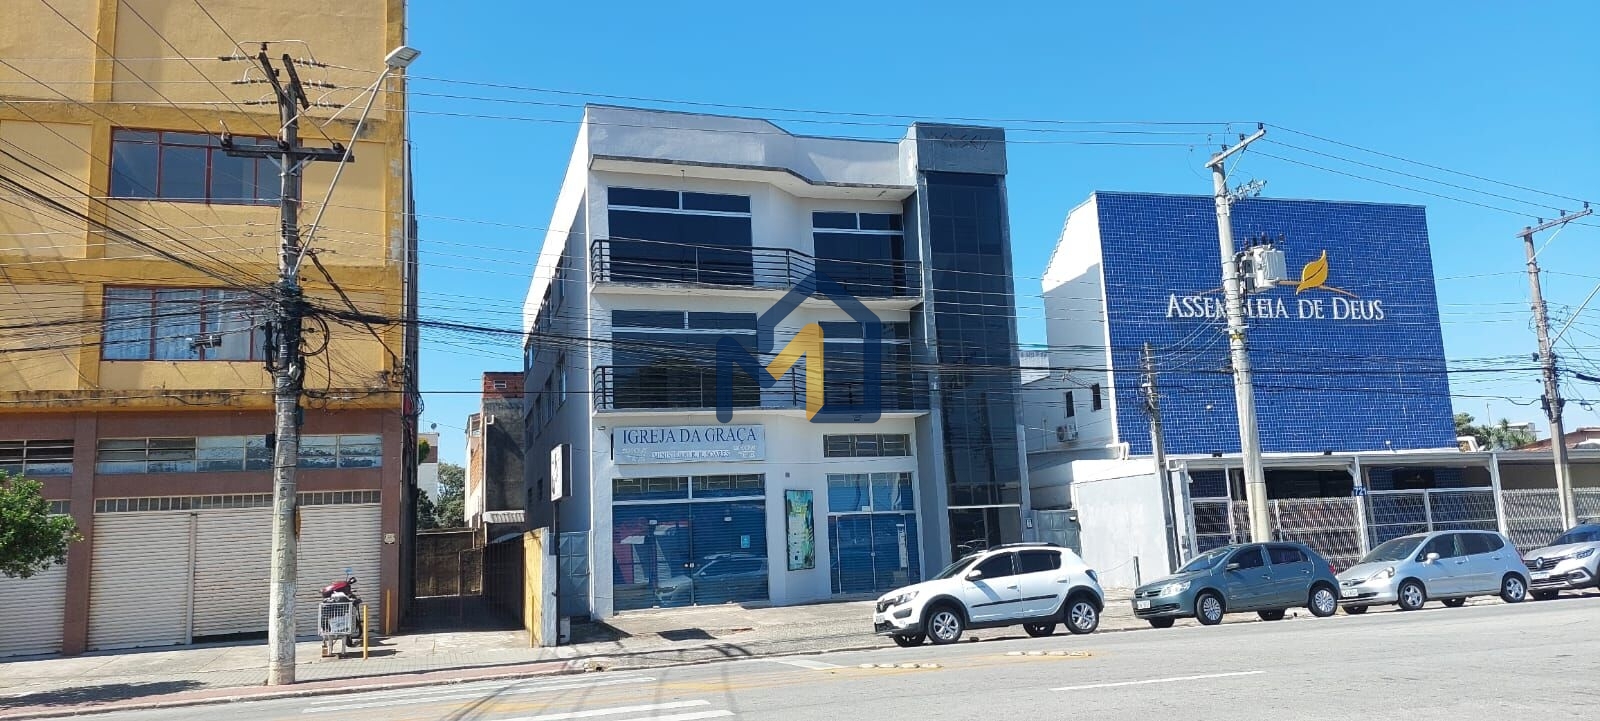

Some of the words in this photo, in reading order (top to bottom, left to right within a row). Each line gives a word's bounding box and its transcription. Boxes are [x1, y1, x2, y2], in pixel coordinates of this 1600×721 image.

[1166, 293, 1290, 319] ASSEMLEIA
[1299, 299, 1325, 319] DE
[1333, 297, 1385, 320] DEUS
[623, 428, 677, 444] IGREJA
[680, 428, 702, 443] DA
[704, 427, 757, 444] GRAÇA
[1354, 487, 1367, 496] 721
